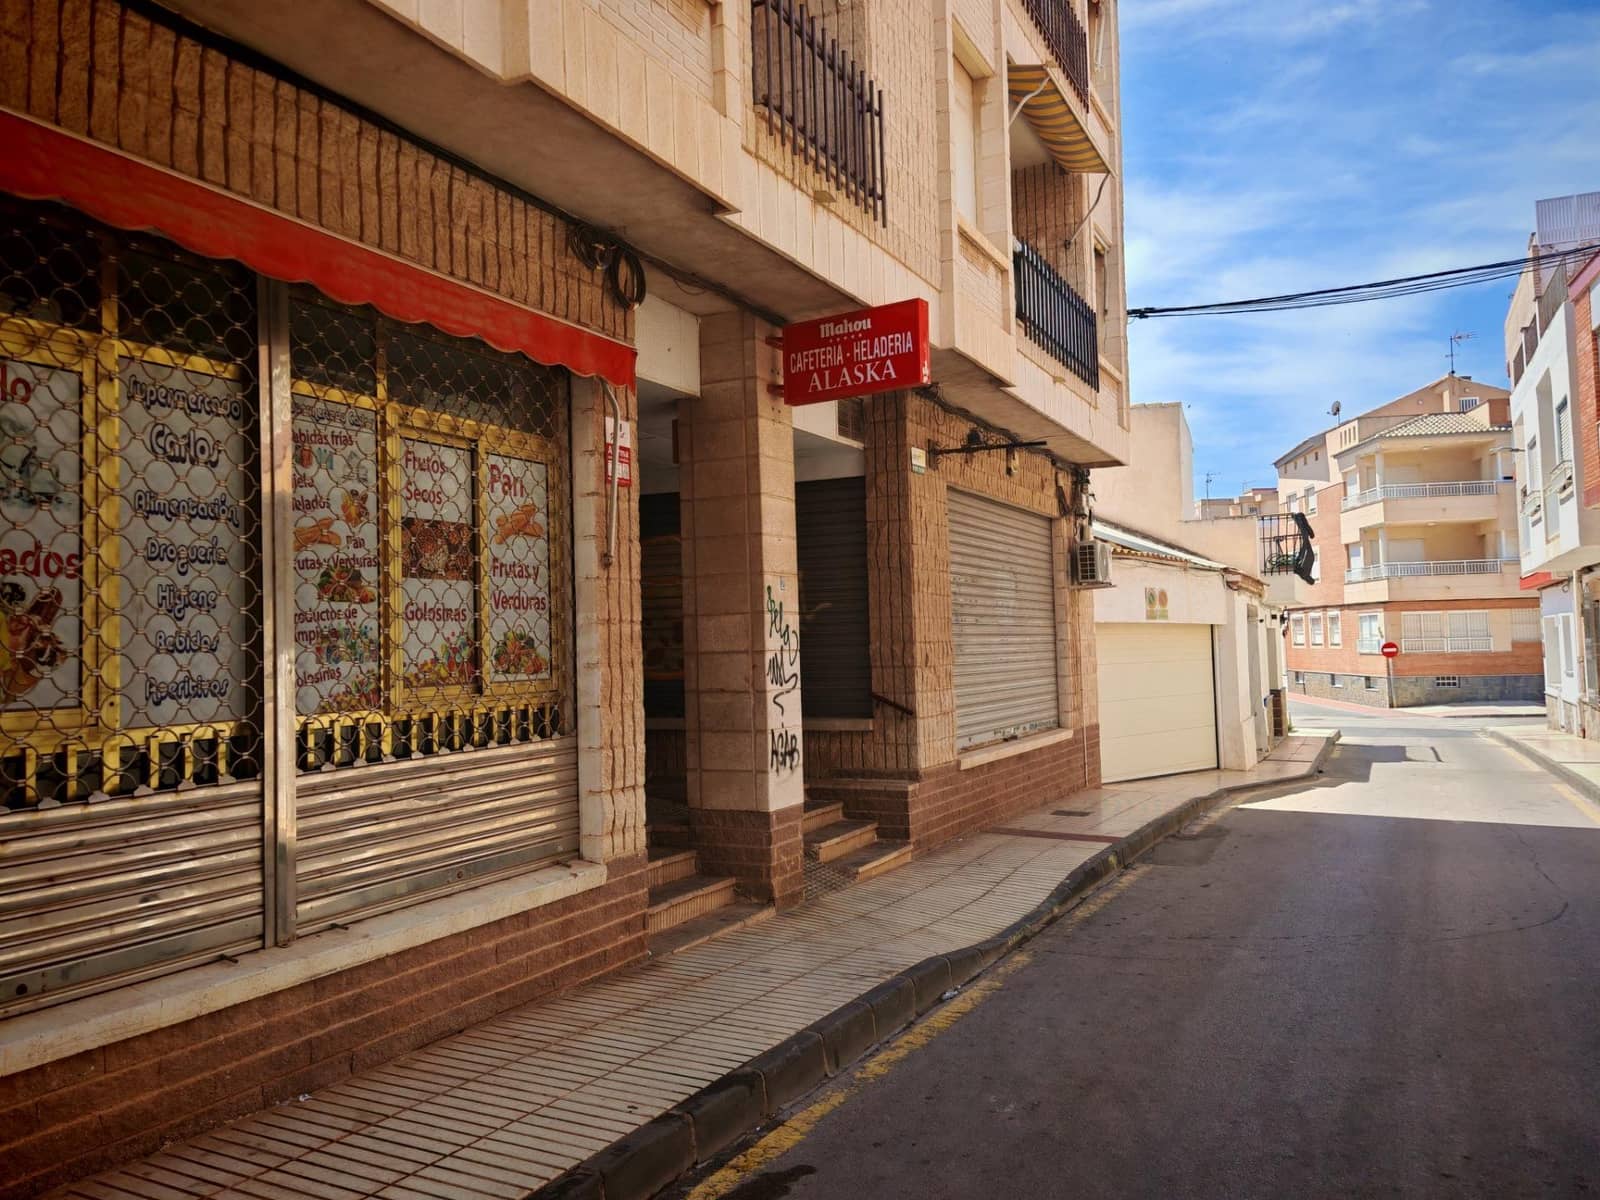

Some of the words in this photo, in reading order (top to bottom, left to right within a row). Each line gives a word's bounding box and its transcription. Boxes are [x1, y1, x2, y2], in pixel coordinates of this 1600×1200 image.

[820, 318, 872, 338] Mahou
[790, 345, 844, 374] CAFETERIA
[853, 331, 913, 362] HELADERIA
[808, 359, 897, 393] ALASKA
[127, 374, 241, 420] Supermercado
[150, 423, 222, 468] Carlos
[404, 447, 447, 474] Frutos
[404, 480, 443, 505] Secos
[490, 463, 524, 498] Pan
[135, 489, 240, 528] Alimentación
[147, 536, 227, 577] Droguería
[332, 554, 378, 569] Verduras
[492, 557, 529, 579] Frutas
[531, 563, 540, 584] y
[157, 584, 217, 621] Higiene
[404, 602, 468, 622] Golosinas
[492, 590, 547, 611] Verduras
